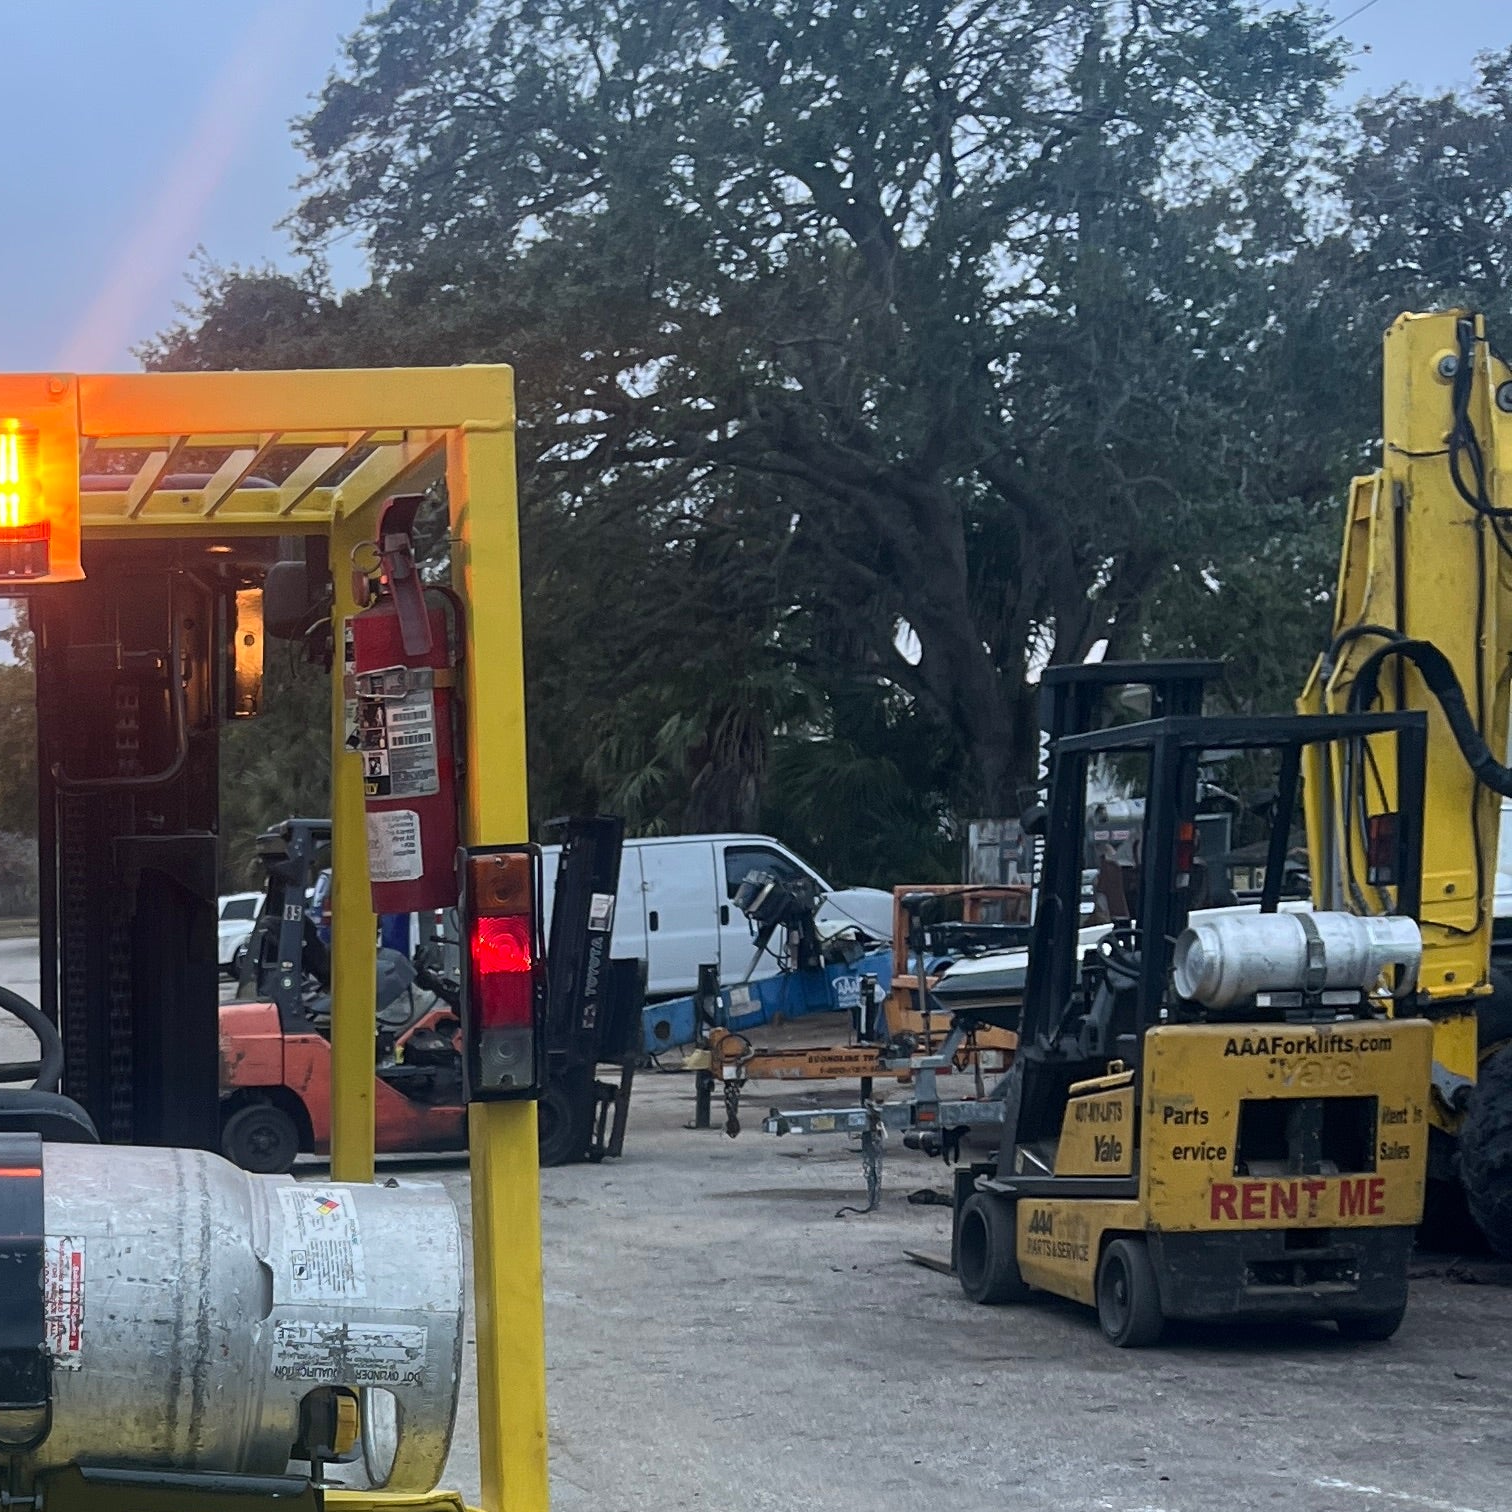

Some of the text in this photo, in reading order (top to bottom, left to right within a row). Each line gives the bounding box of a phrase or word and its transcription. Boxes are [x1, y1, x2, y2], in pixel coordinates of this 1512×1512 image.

[584, 935, 604, 997] TOYOTA
[1224, 1034, 1392, 1057] AAAForklifts.com
[1163, 1105, 1209, 1125] Parts
[1094, 1134, 1123, 1162] Yale
[1380, 1141, 1410, 1160] Sales
[1210, 1178, 1386, 1221] RENT ME
